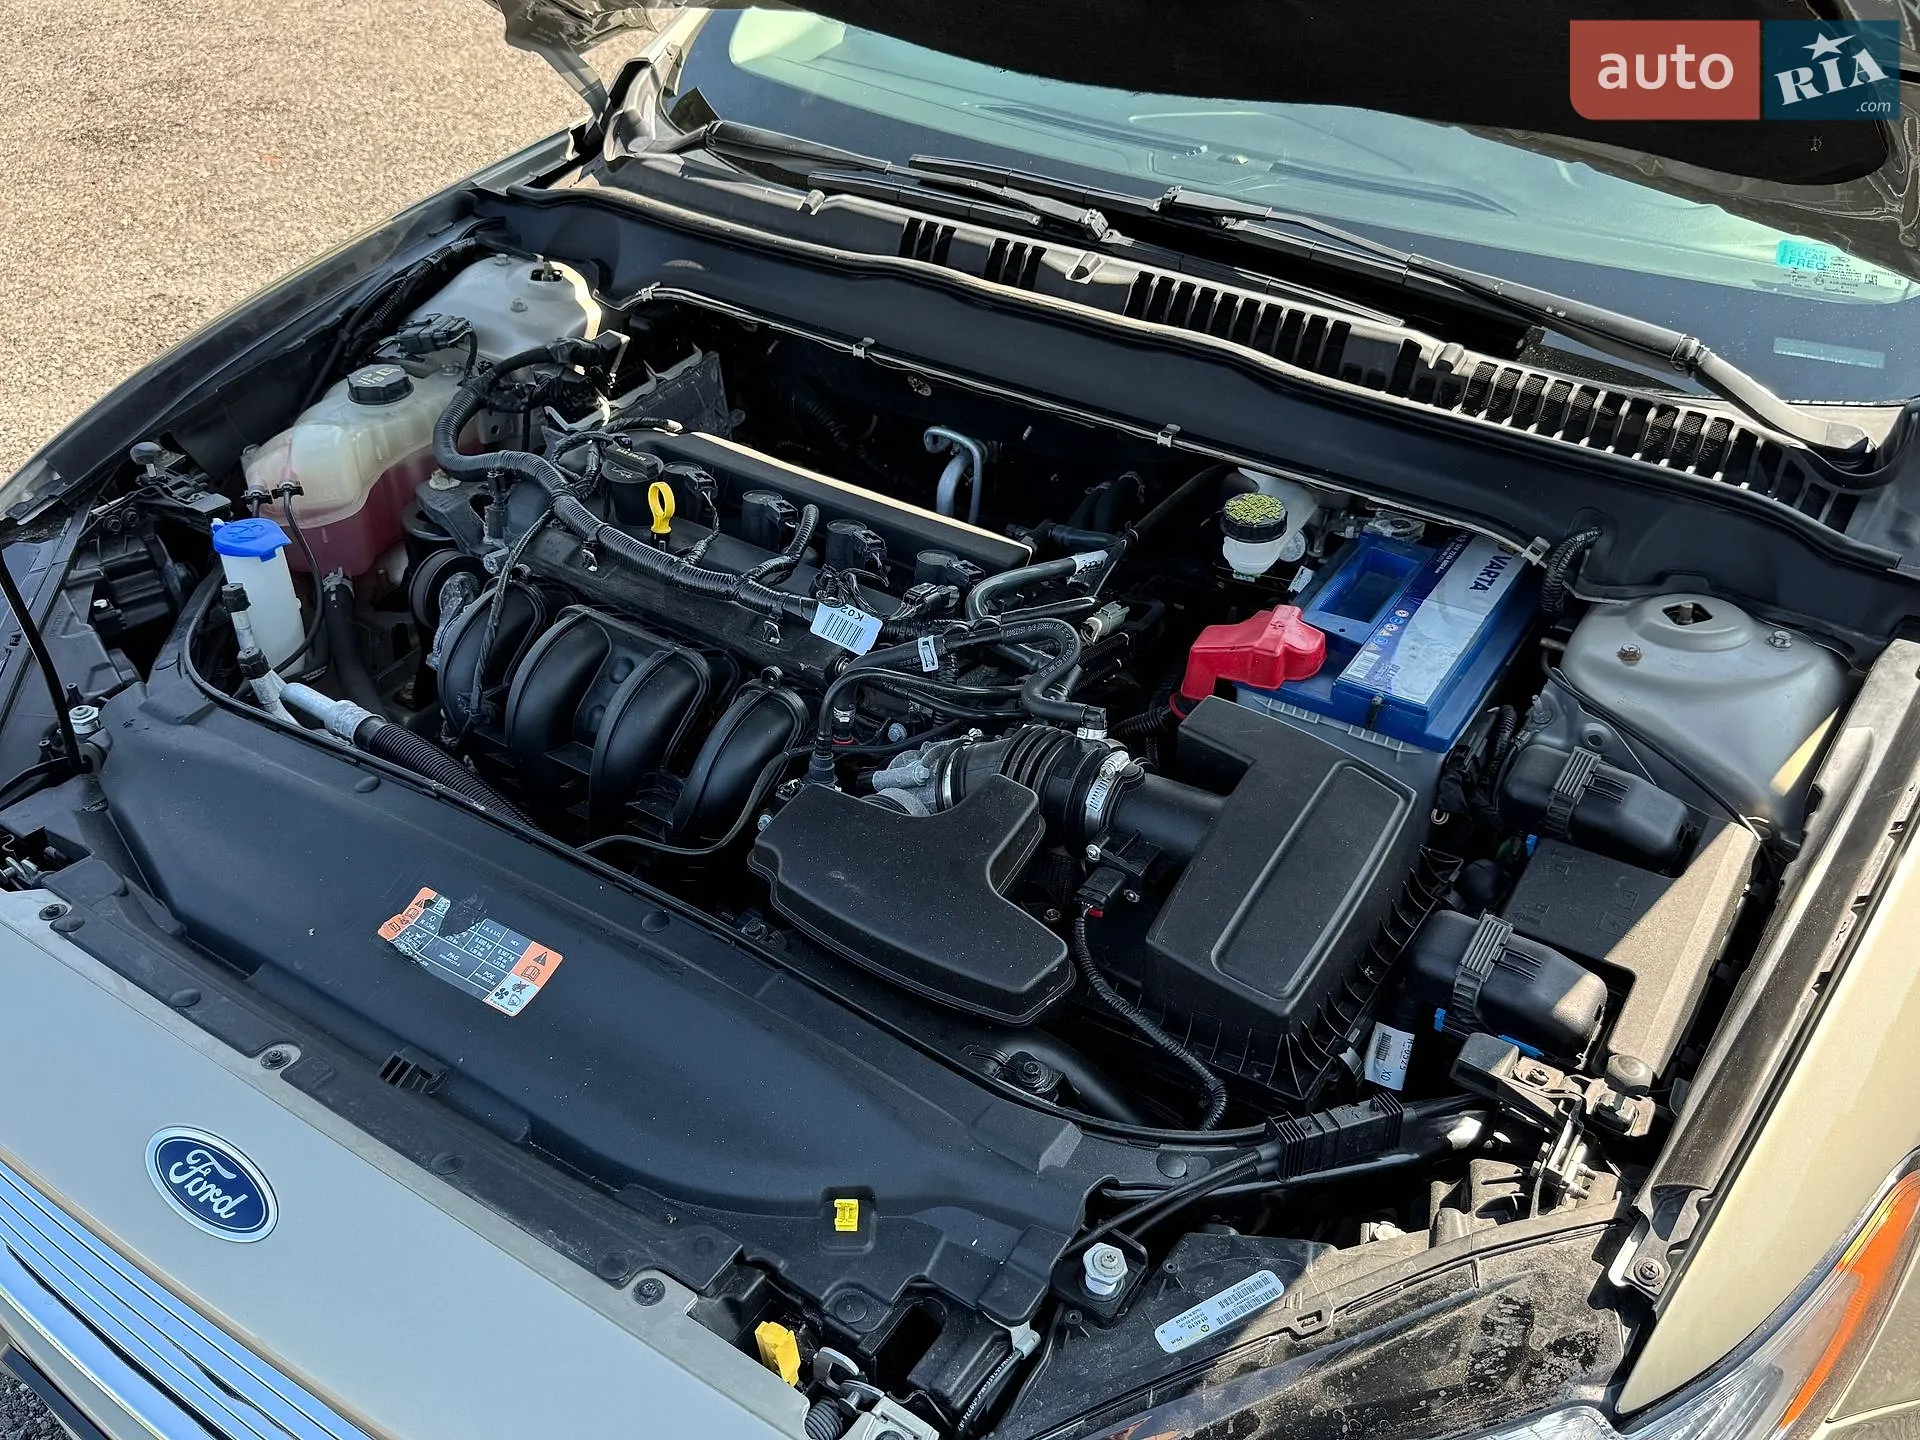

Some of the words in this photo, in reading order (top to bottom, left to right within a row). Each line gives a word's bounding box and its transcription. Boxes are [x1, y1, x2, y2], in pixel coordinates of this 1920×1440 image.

[1469, 555, 1512, 591] VARTA
[840, 605, 865, 622] K02
[168, 1149, 248, 1219] Ford
